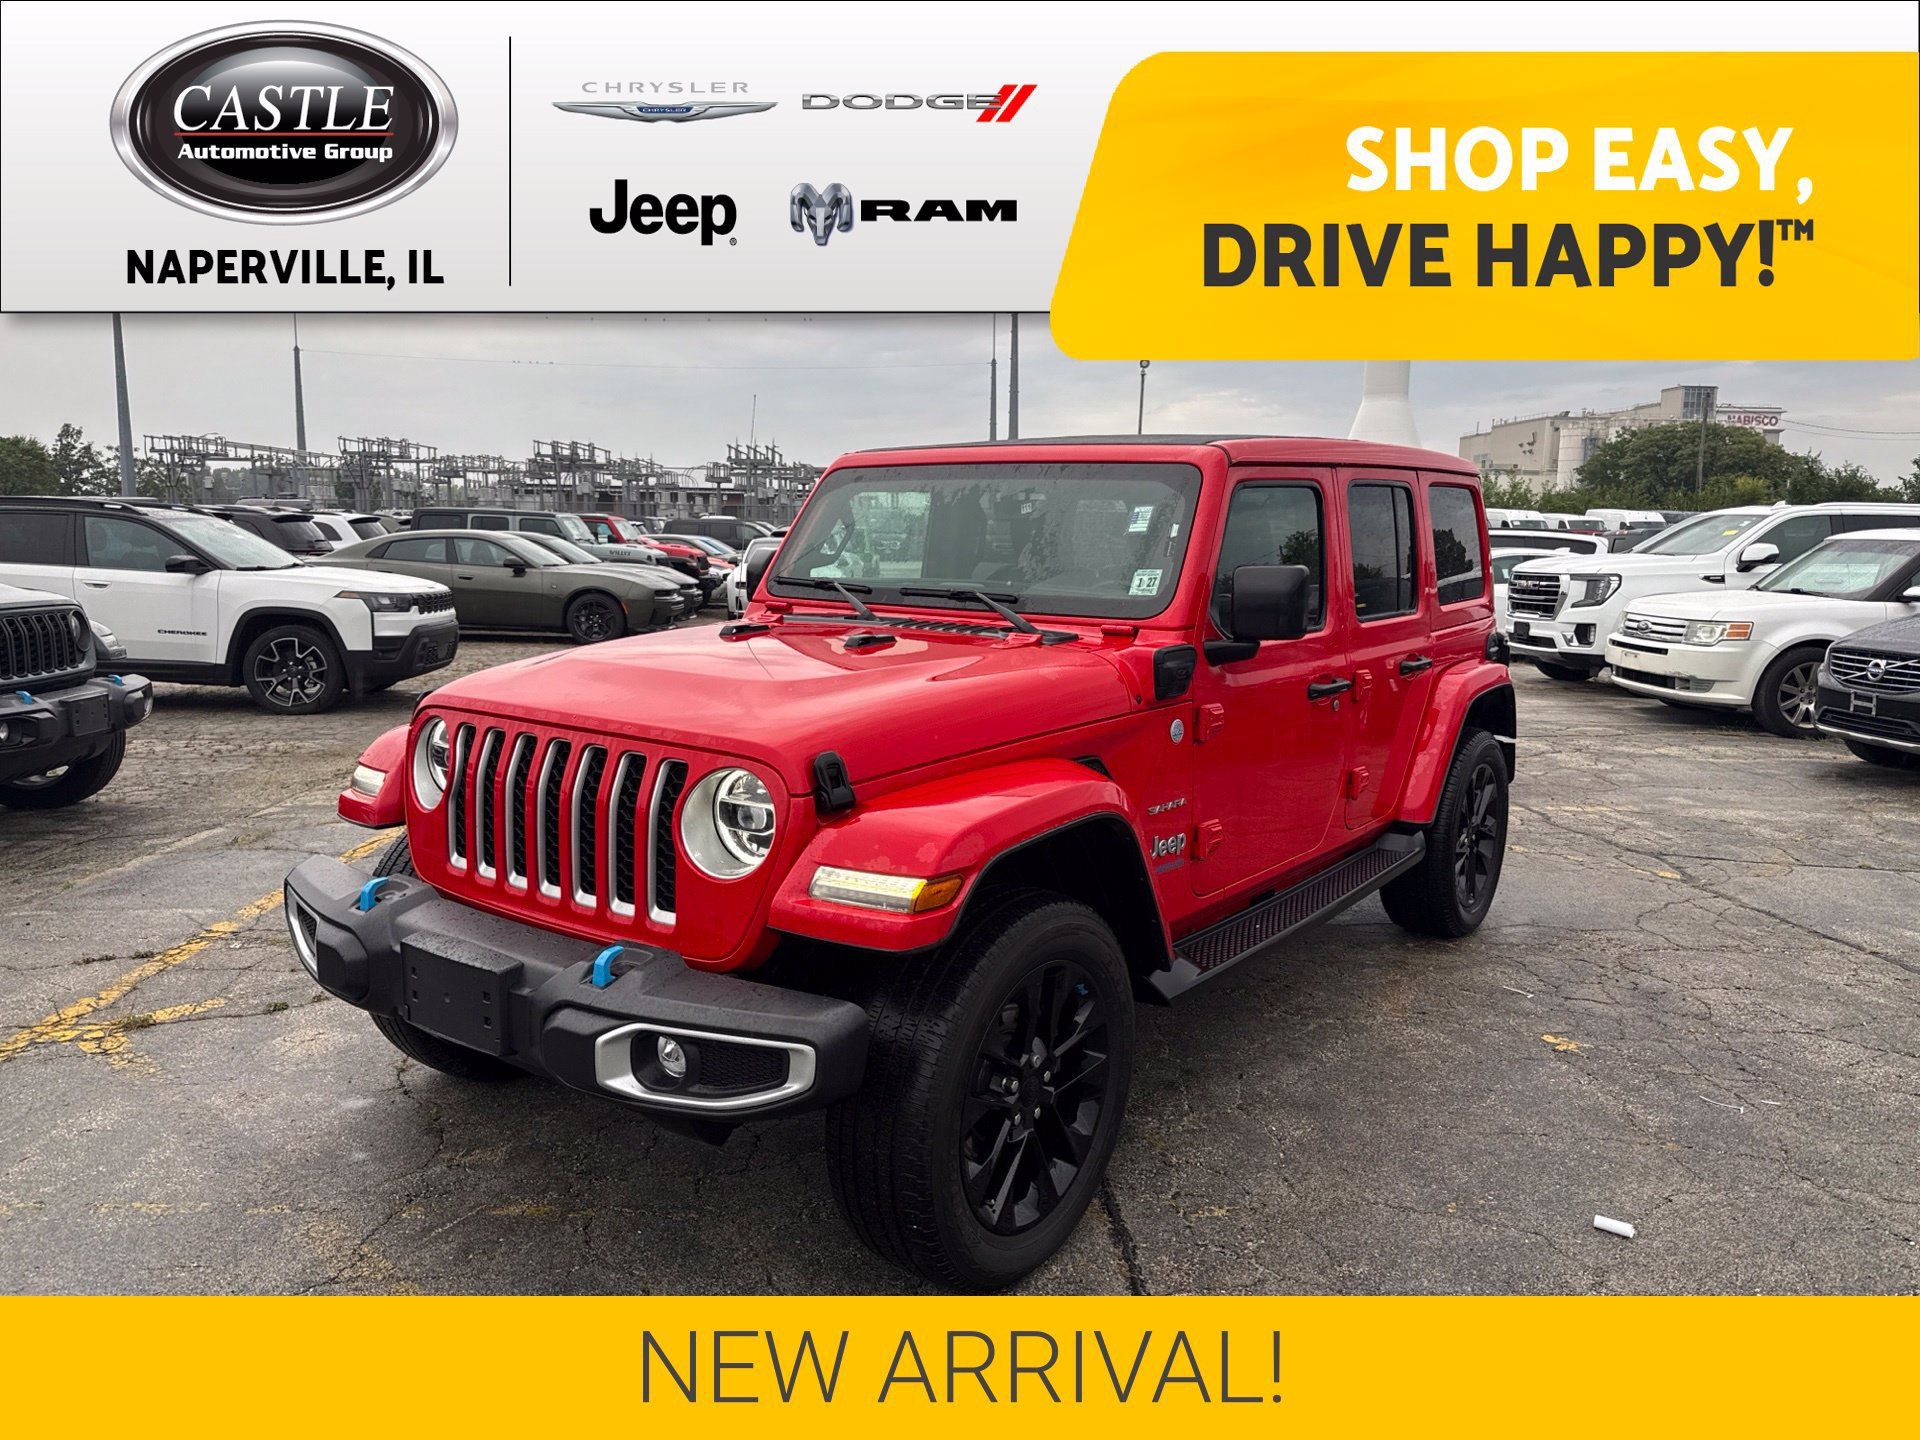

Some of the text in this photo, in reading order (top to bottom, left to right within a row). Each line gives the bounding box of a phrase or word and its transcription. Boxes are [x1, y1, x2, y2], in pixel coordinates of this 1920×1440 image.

[1146, 577, 1158, 587] 27
[157, 629, 208, 637] CHEROKEE
[1150, 832, 1187, 859] Jeep
